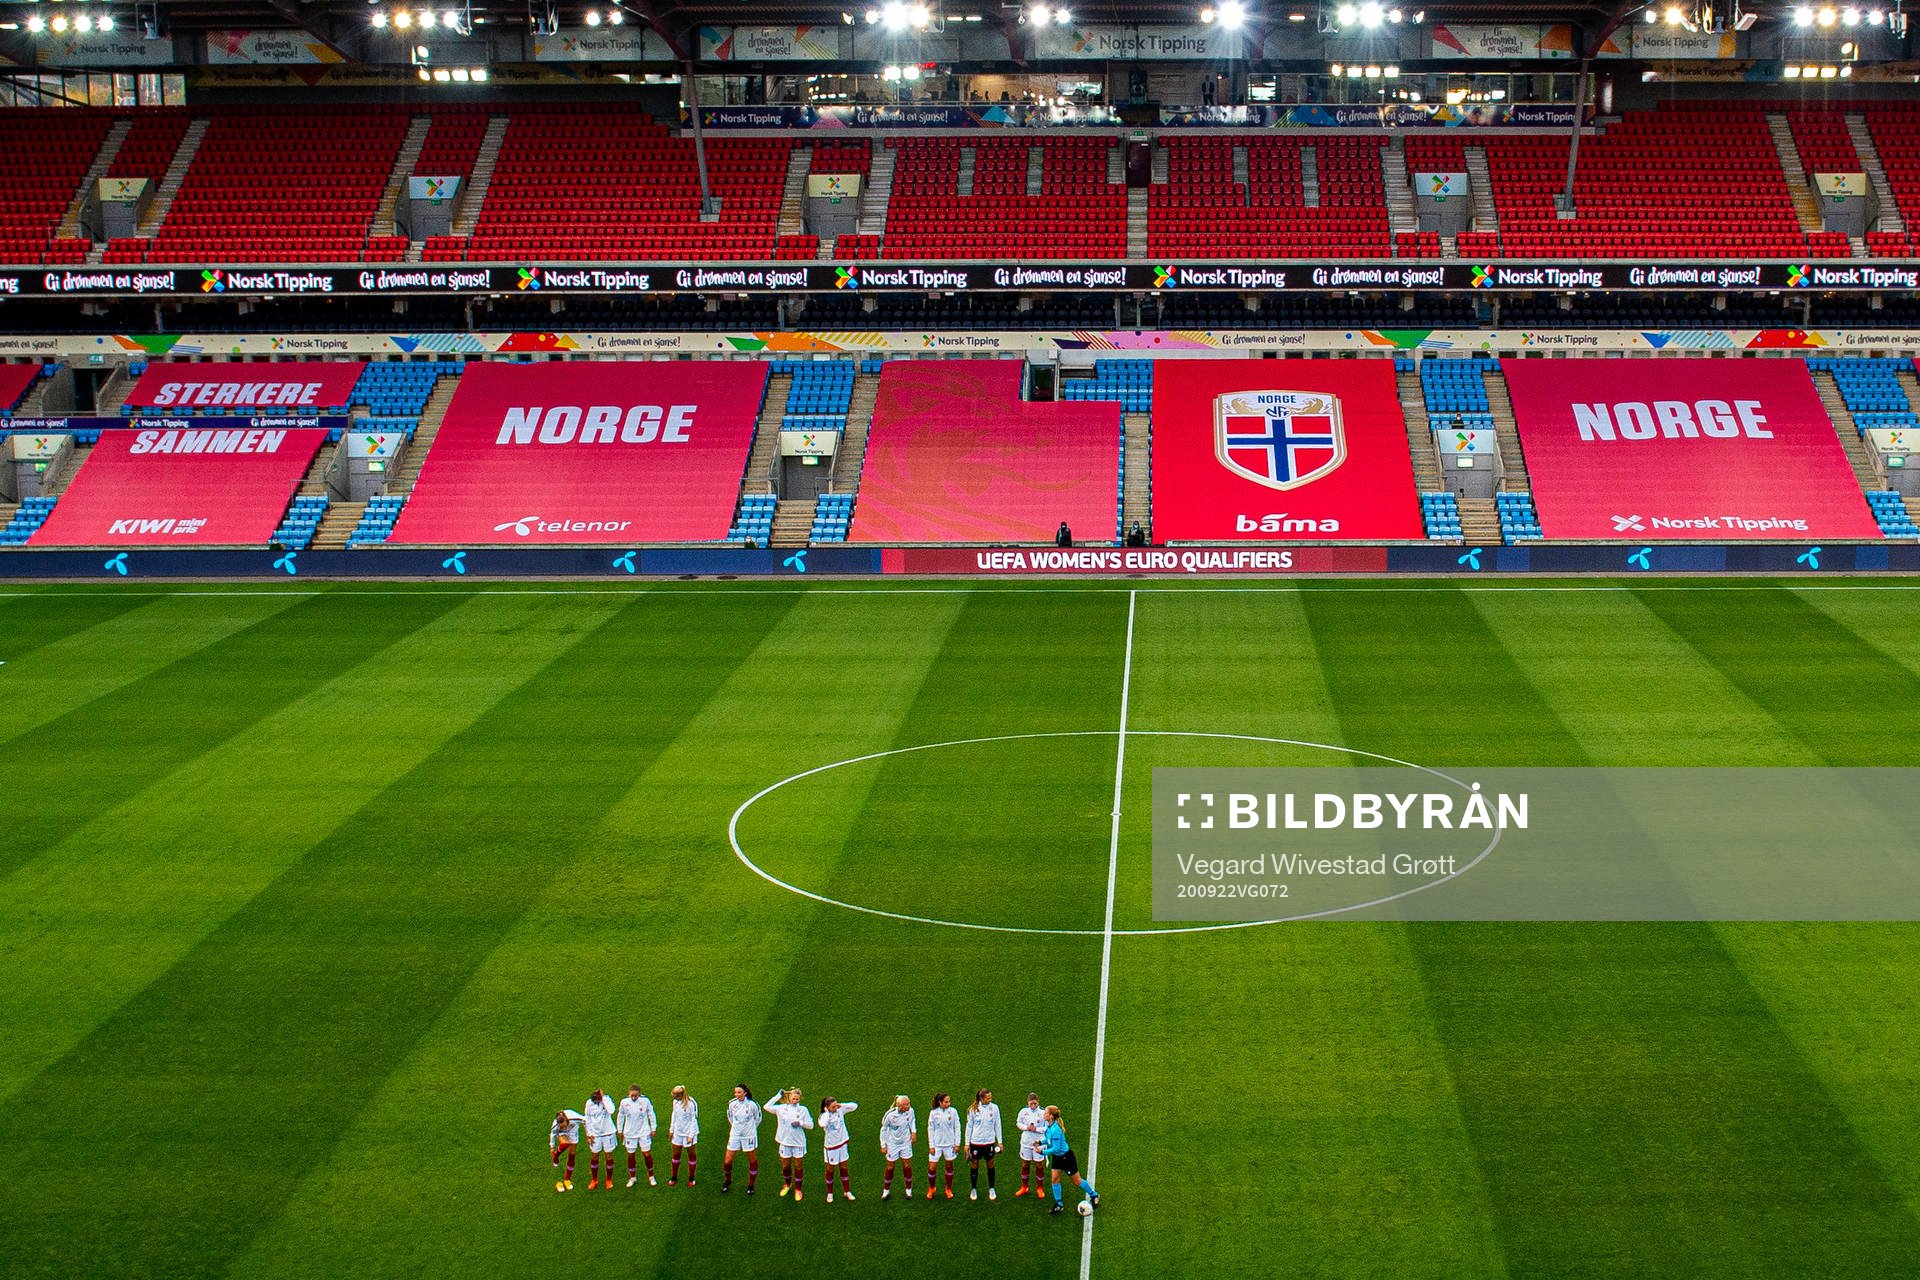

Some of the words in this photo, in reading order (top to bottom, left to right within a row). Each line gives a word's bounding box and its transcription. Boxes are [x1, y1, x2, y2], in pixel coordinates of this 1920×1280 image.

[580, 39, 609, 49] Norsk
[1100, 35, 1145, 50] Norsk
[1147, 35, 1206, 53] Tipping
[1642, 38, 1672, 47] Norsk
[1673, 37, 1709, 49] Tipping
[720, 114, 747, 123] Norsk
[748, 114, 782, 125] Tipping
[919, 109, 949, 125] sjanse!
[1518, 112, 1544, 121] Norsk
[45, 272, 60, 291] Gi
[64, 272, 114, 290] drømmen
[115, 275, 131, 288] en
[132, 272, 175, 293] sjanse!
[228, 273, 273, 289] Norsk
[274, 273, 332, 292] Tipping
[359, 271, 375, 289] Gi
[378, 270, 429, 289] drømmen
[430, 273, 446, 287] en
[448, 269, 491, 290] sjanse!
[544, 271, 590, 287] Norsk
[591, 271, 649, 290] Tipping
[676, 269, 692, 288] Gi
[695, 268, 746, 287] drømmen
[747, 272, 763, 285] en
[765, 268, 808, 289] sjanse!
[862, 269, 908, 285] Norsk
[909, 269, 968, 288] Tipping
[994, 268, 1010, 286] Gi
[1013, 267, 1064, 285] drømmen
[1066, 270, 1082, 284] en
[1083, 267, 1127, 288] sjanse!
[1181, 268, 1227, 284] Norsk
[1228, 268, 1286, 287] Tipping
[1312, 267, 1328, 286] Gi
[1330, 267, 1382, 286] drømmen
[1384, 270, 1400, 283] en
[1402, 267, 1445, 287] sjanse!
[1498, 268, 1544, 284] Norsk
[1545, 268, 1603, 287] Tipping
[1630, 267, 1645, 286] Gi
[1647, 266, 1699, 285] drømmen
[1700, 270, 1716, 283] en
[1718, 266, 1761, 287] sjanse!
[1814, 268, 1860, 284] Norsk
[1861, 268, 1918, 287] Tipping
[287, 339, 313, 348] Norsk
[314, 339, 348, 350] Tipping
[597, 336, 608, 347] Gi
[654, 336, 681, 349] sjanse!
[938, 336, 965, 345] Norsk
[966, 336, 1000, 347] Tipping
[1222, 334, 1232, 345] Gi
[1279, 333, 1306, 346] sjanse!
[1537, 335, 1563, 344] Norsk
[1564, 335, 1598, 345] Tipping
[154, 382, 322, 405] STERKERE
[1257, 394, 1297, 404] NORGE
[141, 419, 162, 428] Norsk
[163, 419, 190, 429] Tipping
[495, 405, 698, 445] NORGE
[1571, 399, 1775, 442] NORGE
[129, 430, 287, 454] SAMMEN
[107, 519, 177, 535] KIWI
[172, 526, 199, 535] pris
[177, 518, 207, 527] mini
[538, 518, 631, 532] telenor
[1651, 516, 1720, 529] Norsk
[1720, 516, 1809, 531] Tipping
[977, 552, 1028, 569] UEFA
[1029, 551, 1122, 569] WOMEN'S
[1125, 551, 1178, 569] EURO
[1181, 551, 1293, 573] QUALIFIERS
